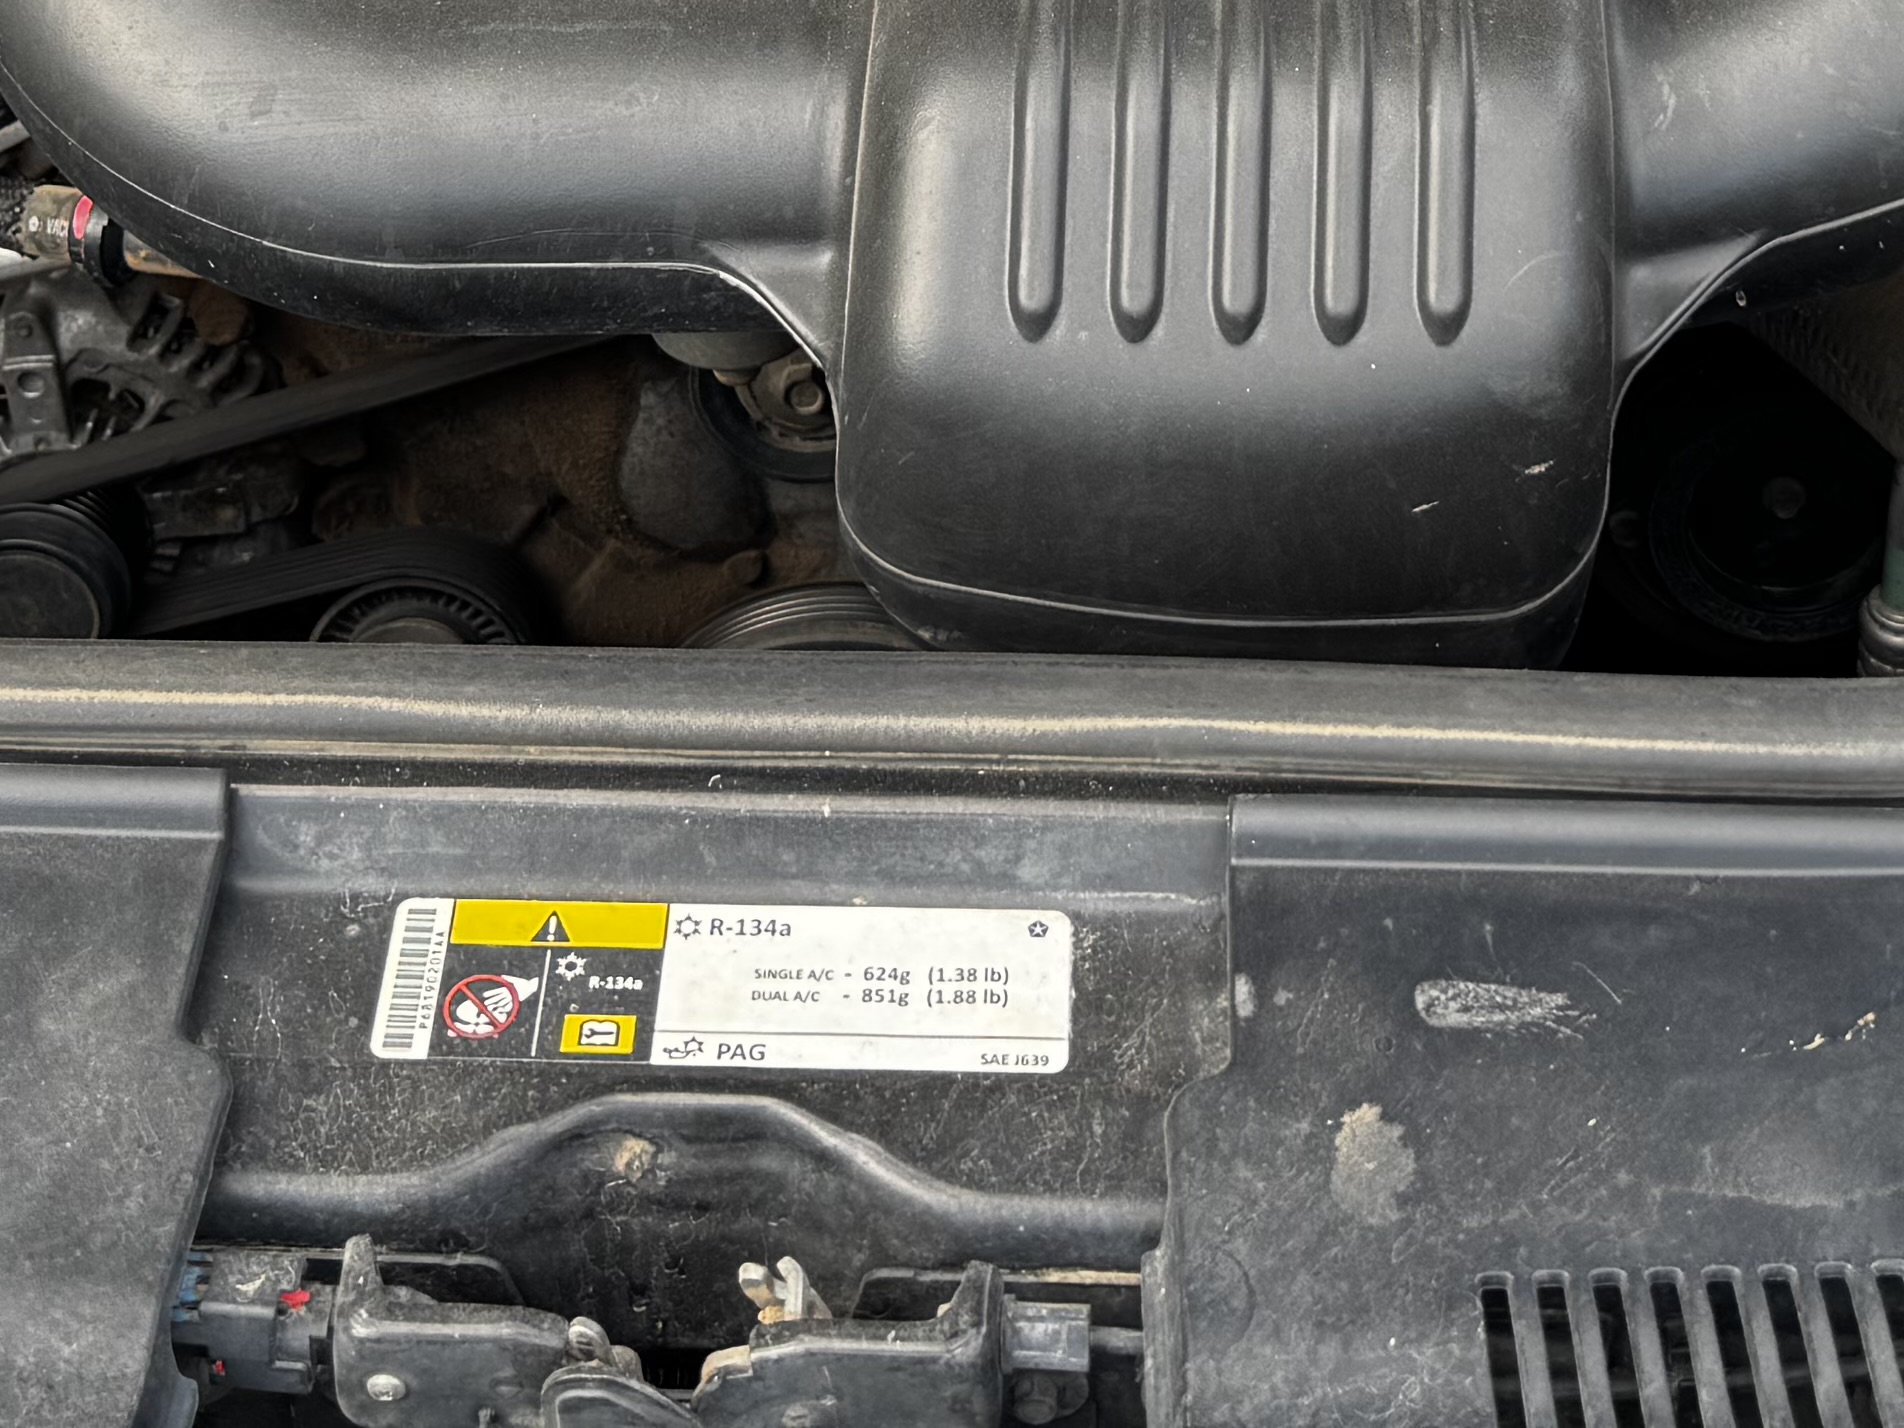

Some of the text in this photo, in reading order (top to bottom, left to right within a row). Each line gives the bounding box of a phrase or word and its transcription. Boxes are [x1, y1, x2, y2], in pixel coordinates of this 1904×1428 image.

[709, 918, 793, 937] R-134a
[588, 975, 644, 991] R-134a
[753, 967, 803, 981] SINGLE
[807, 968, 835, 982] A/C
[863, 966, 911, 986] 624g
[927, 966, 978, 985] (1.38
[983, 966, 1010, 985] lb)
[751, 989, 790, 1002] DUAL
[793, 990, 821, 1003] A/C
[861, 988, 910, 1007] 851g
[926, 989, 978, 1008] (1.88
[982, 989, 1009, 1008] lb)
[716, 1042, 767, 1061] PAG
[979, 1052, 1050, 1067] SAE J639
